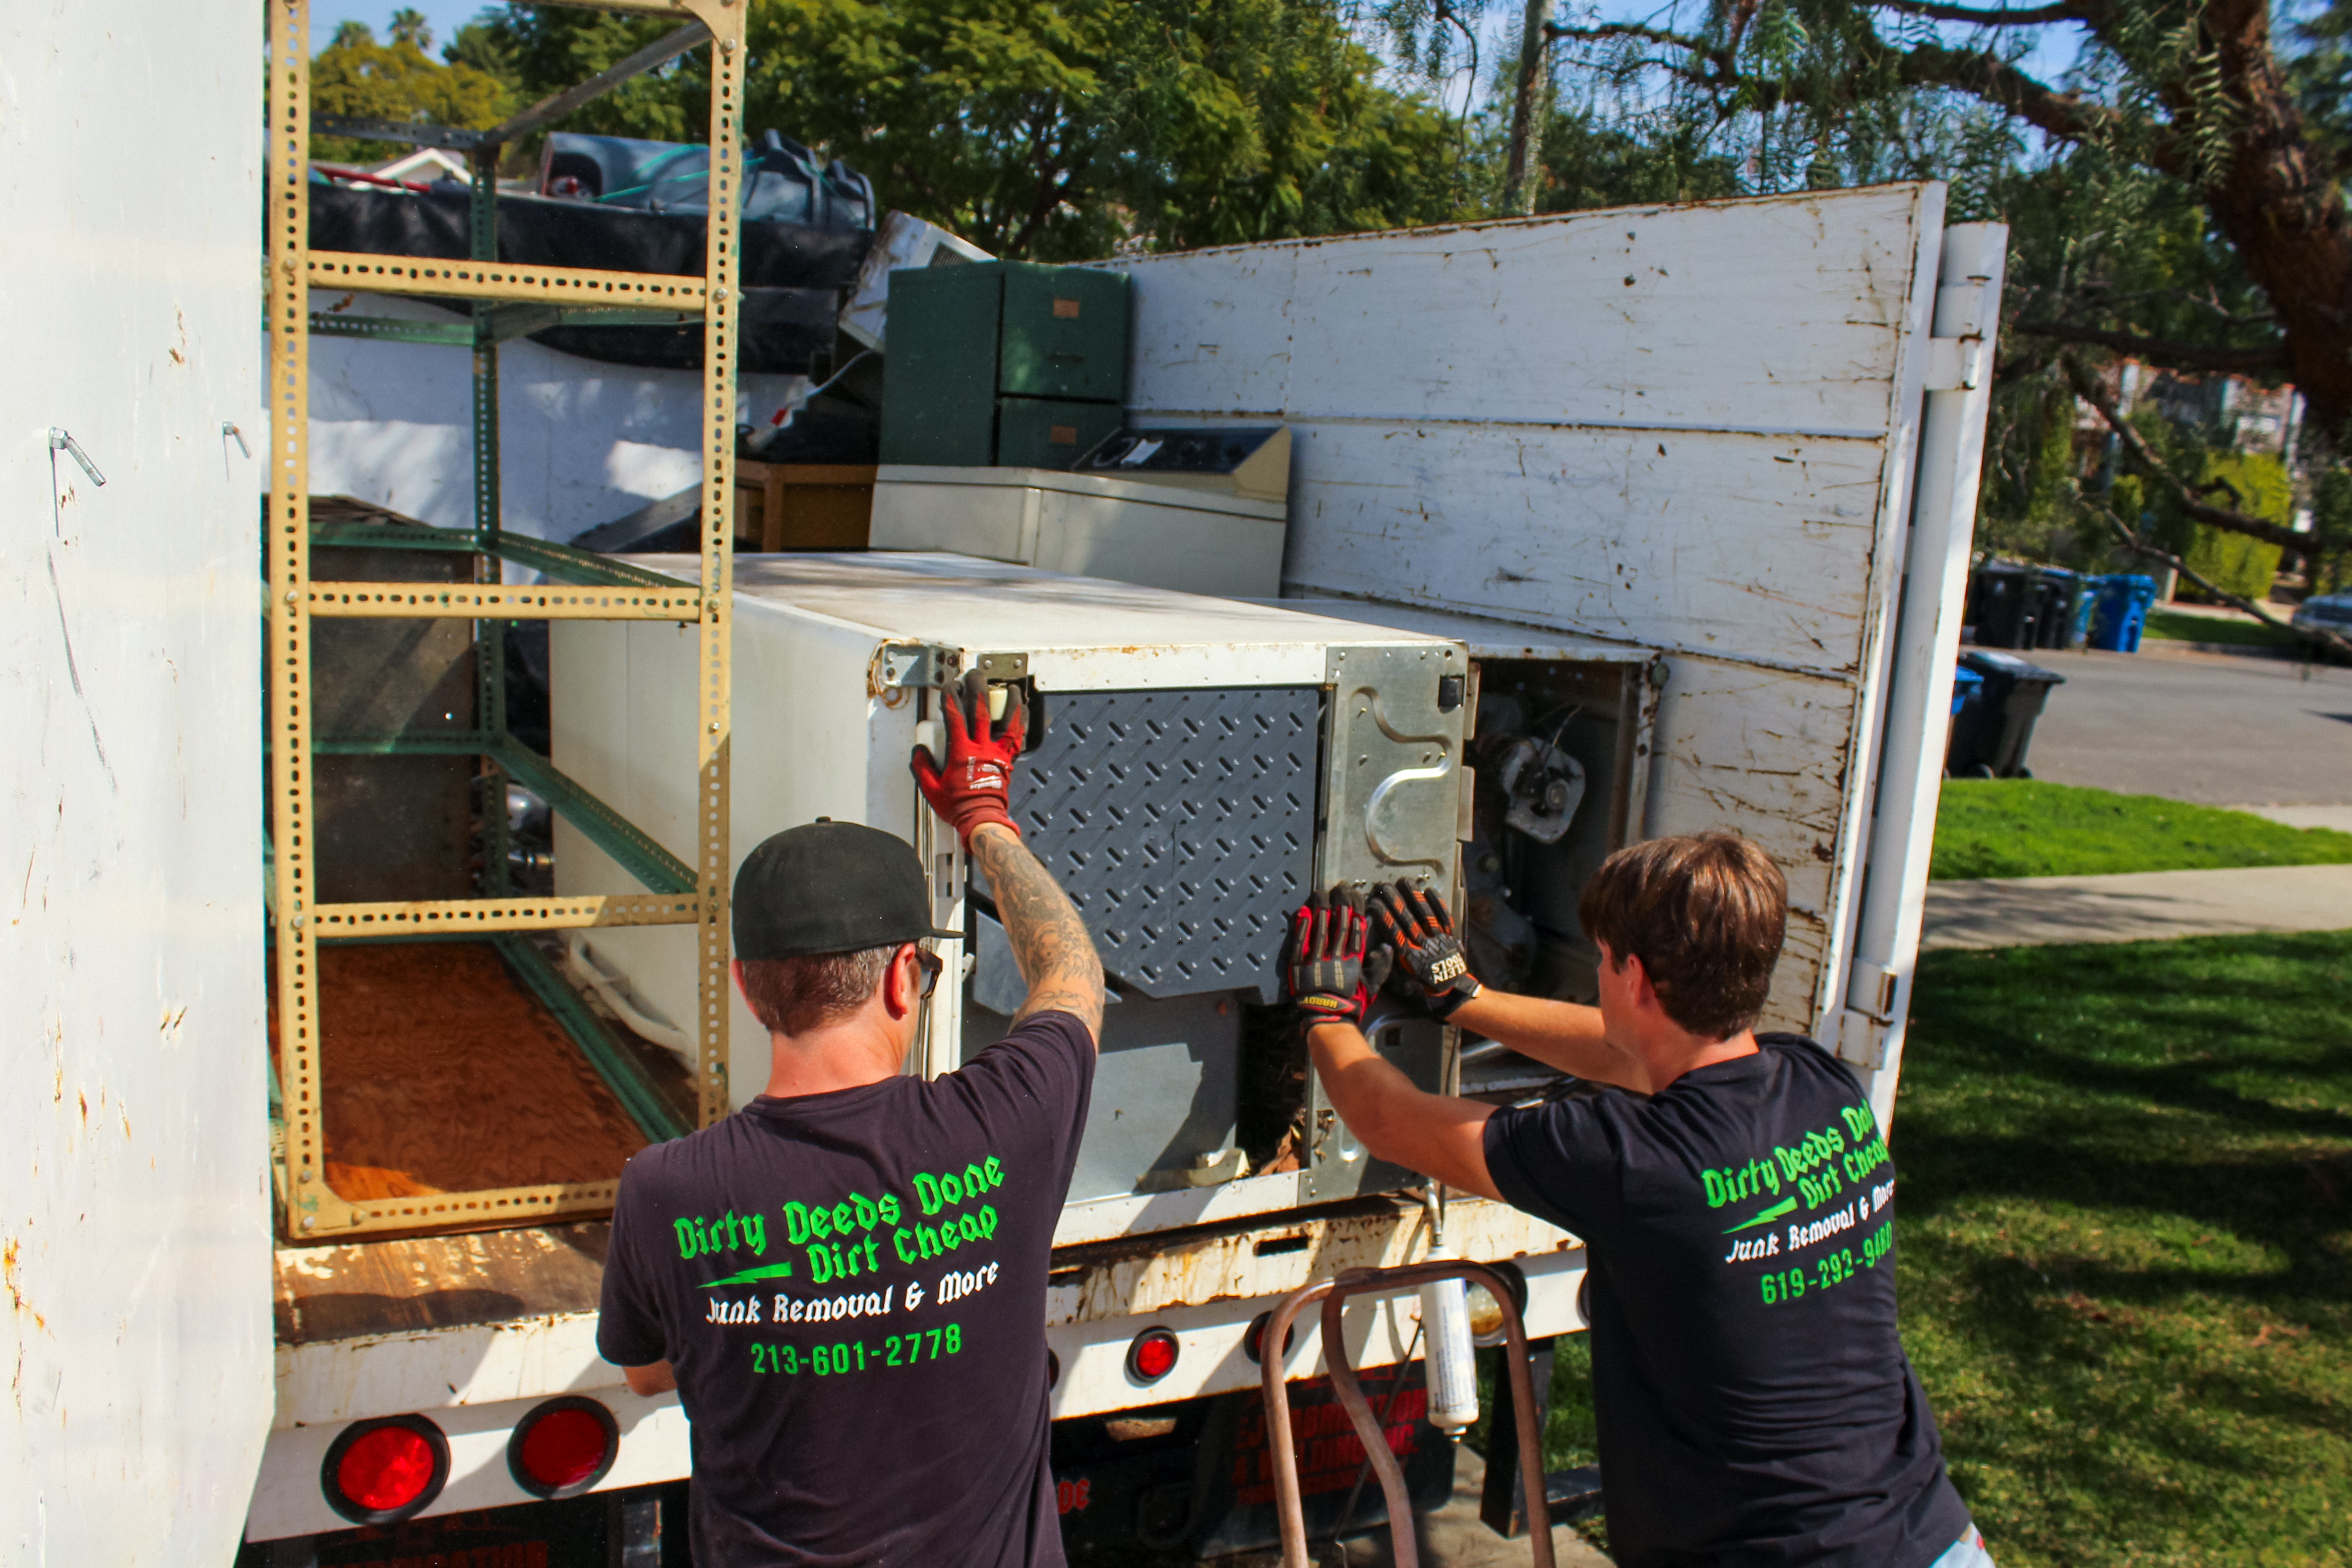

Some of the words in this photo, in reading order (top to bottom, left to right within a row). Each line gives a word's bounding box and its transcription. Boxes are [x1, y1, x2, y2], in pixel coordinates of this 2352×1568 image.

[1700, 1158, 1781, 1208] Dirty
[1773, 1126, 1845, 1182] Deeds
[1797, 1163, 1843, 1210] Dirt
[672, 1209, 767, 1259] Dirty
[782, 1191, 902, 1245] Deeds
[911, 1155, 1005, 1216] Done
[1724, 1232, 1780, 1264] Junk
[1788, 1202, 1855, 1251] Removal
[1859, 1195, 1870, 1221] &
[805, 1233, 881, 1284] Dirt
[892, 1204, 999, 1265] Cheap
[705, 1295, 761, 1325] Junk
[772, 1284, 894, 1323] Removal
[905, 1281, 925, 1311] &
[936, 1261, 999, 1305] More
[751, 1323, 962, 1376] 213-601-2778
